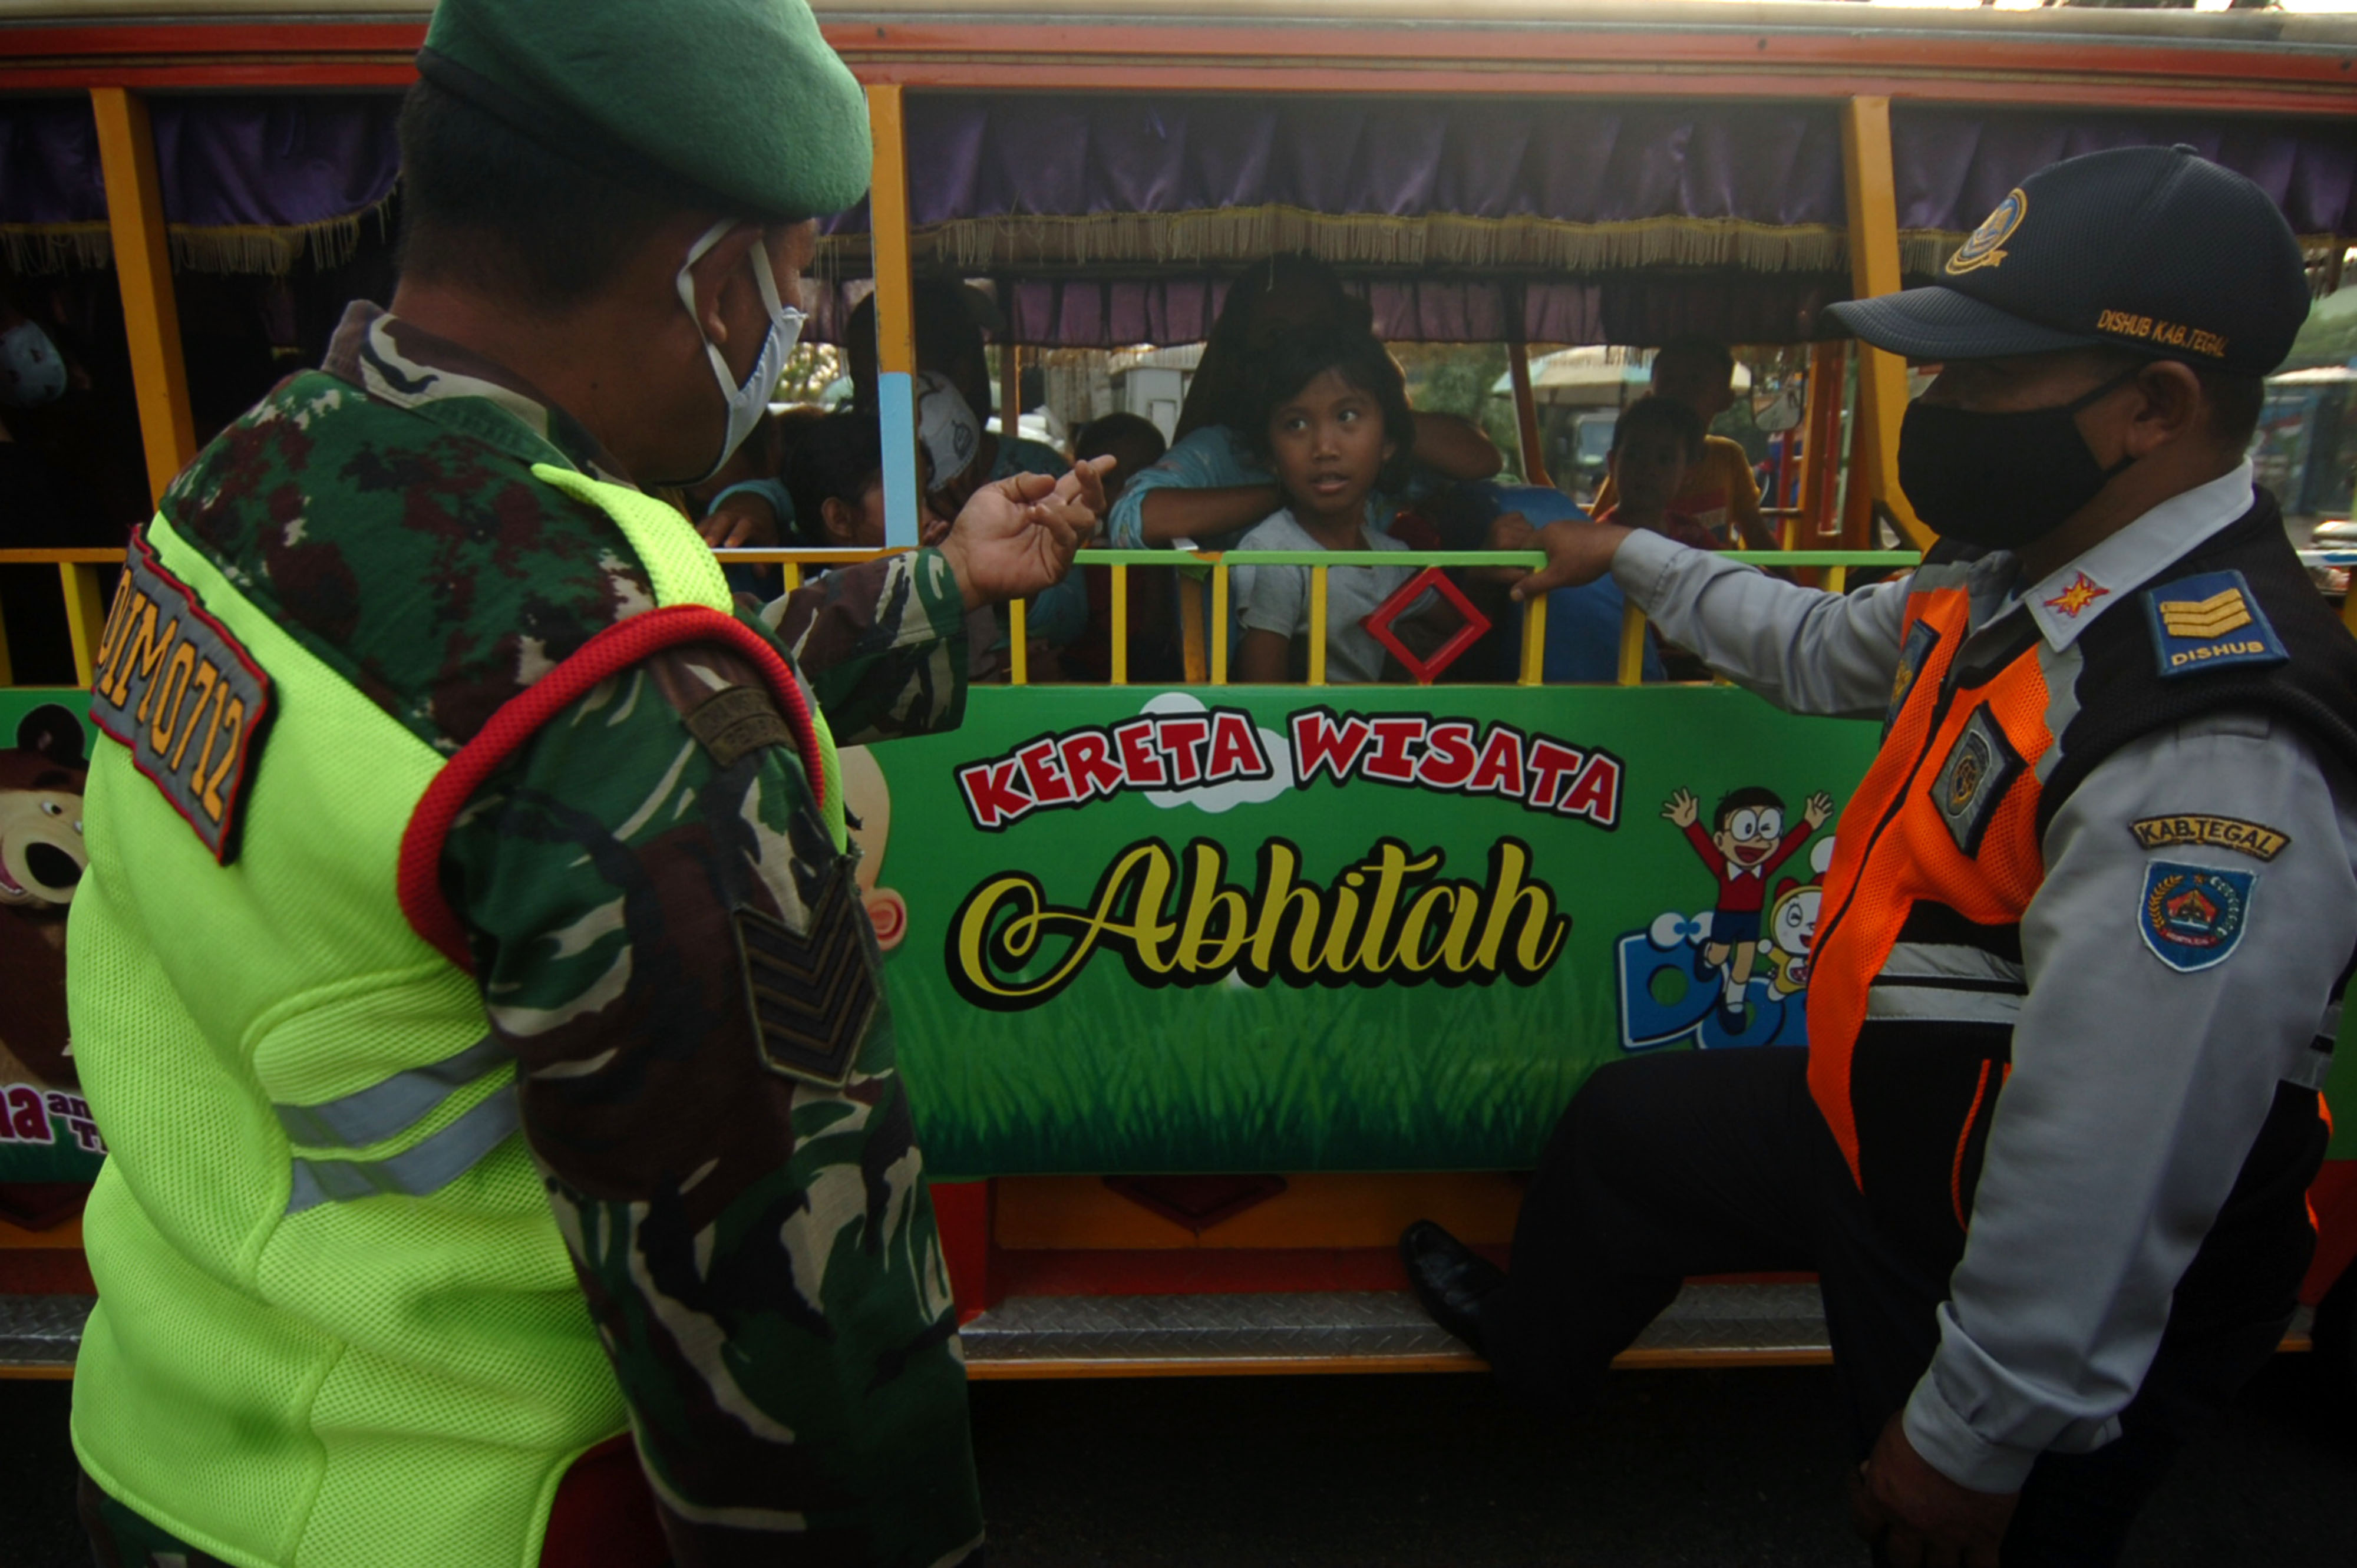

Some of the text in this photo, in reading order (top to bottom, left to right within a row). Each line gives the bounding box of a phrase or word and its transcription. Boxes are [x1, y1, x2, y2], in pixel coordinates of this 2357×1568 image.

[2097, 309, 2153, 337] DISHUB
[2171, 641, 2264, 666] DISHUB
[958, 710, 1623, 828] KERETA WISATA
[955, 840, 1567, 1000] Abhitah
